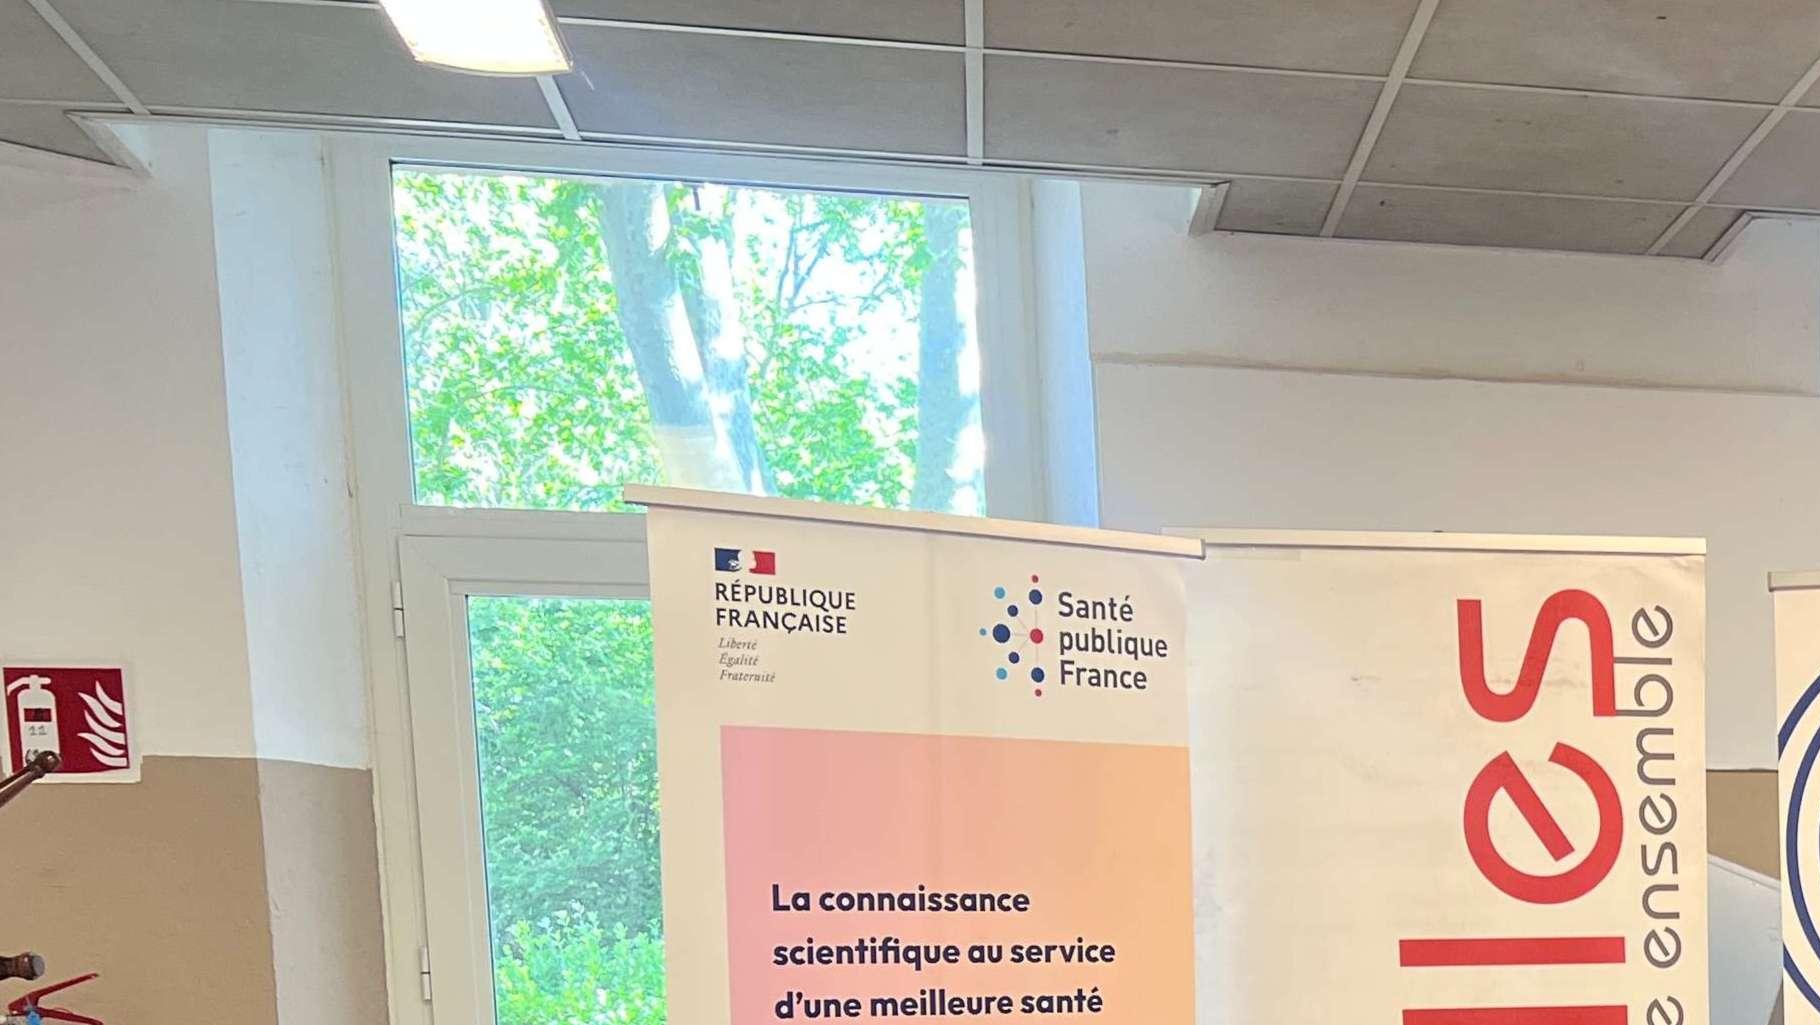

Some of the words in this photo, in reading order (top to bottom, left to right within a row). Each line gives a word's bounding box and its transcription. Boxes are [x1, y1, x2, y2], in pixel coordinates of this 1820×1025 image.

[715, 579, 857, 611] RÉPUBLIQUE
[1058, 591, 1135, 623] Santé
[715, 607, 848, 635] FRANÇAISE
[718, 637, 758, 651] Liberté
[1059, 626, 1169, 661] publique
[718, 652, 759, 668] Égalité
[1060, 659, 1148, 691] France
[719, 669, 776, 684] Fraternité
[1613, 604, 1682, 969] ensemble
[771, 883, 811, 912] La
[818, 884, 1031, 912] connaissance
[772, 936, 961, 972] scientifique
[967, 944, 1003, 965] au
[1009, 936, 1117, 965] service
[870, 988, 1014, 1017] meilleure
[1020, 985, 1104, 1014] santé
